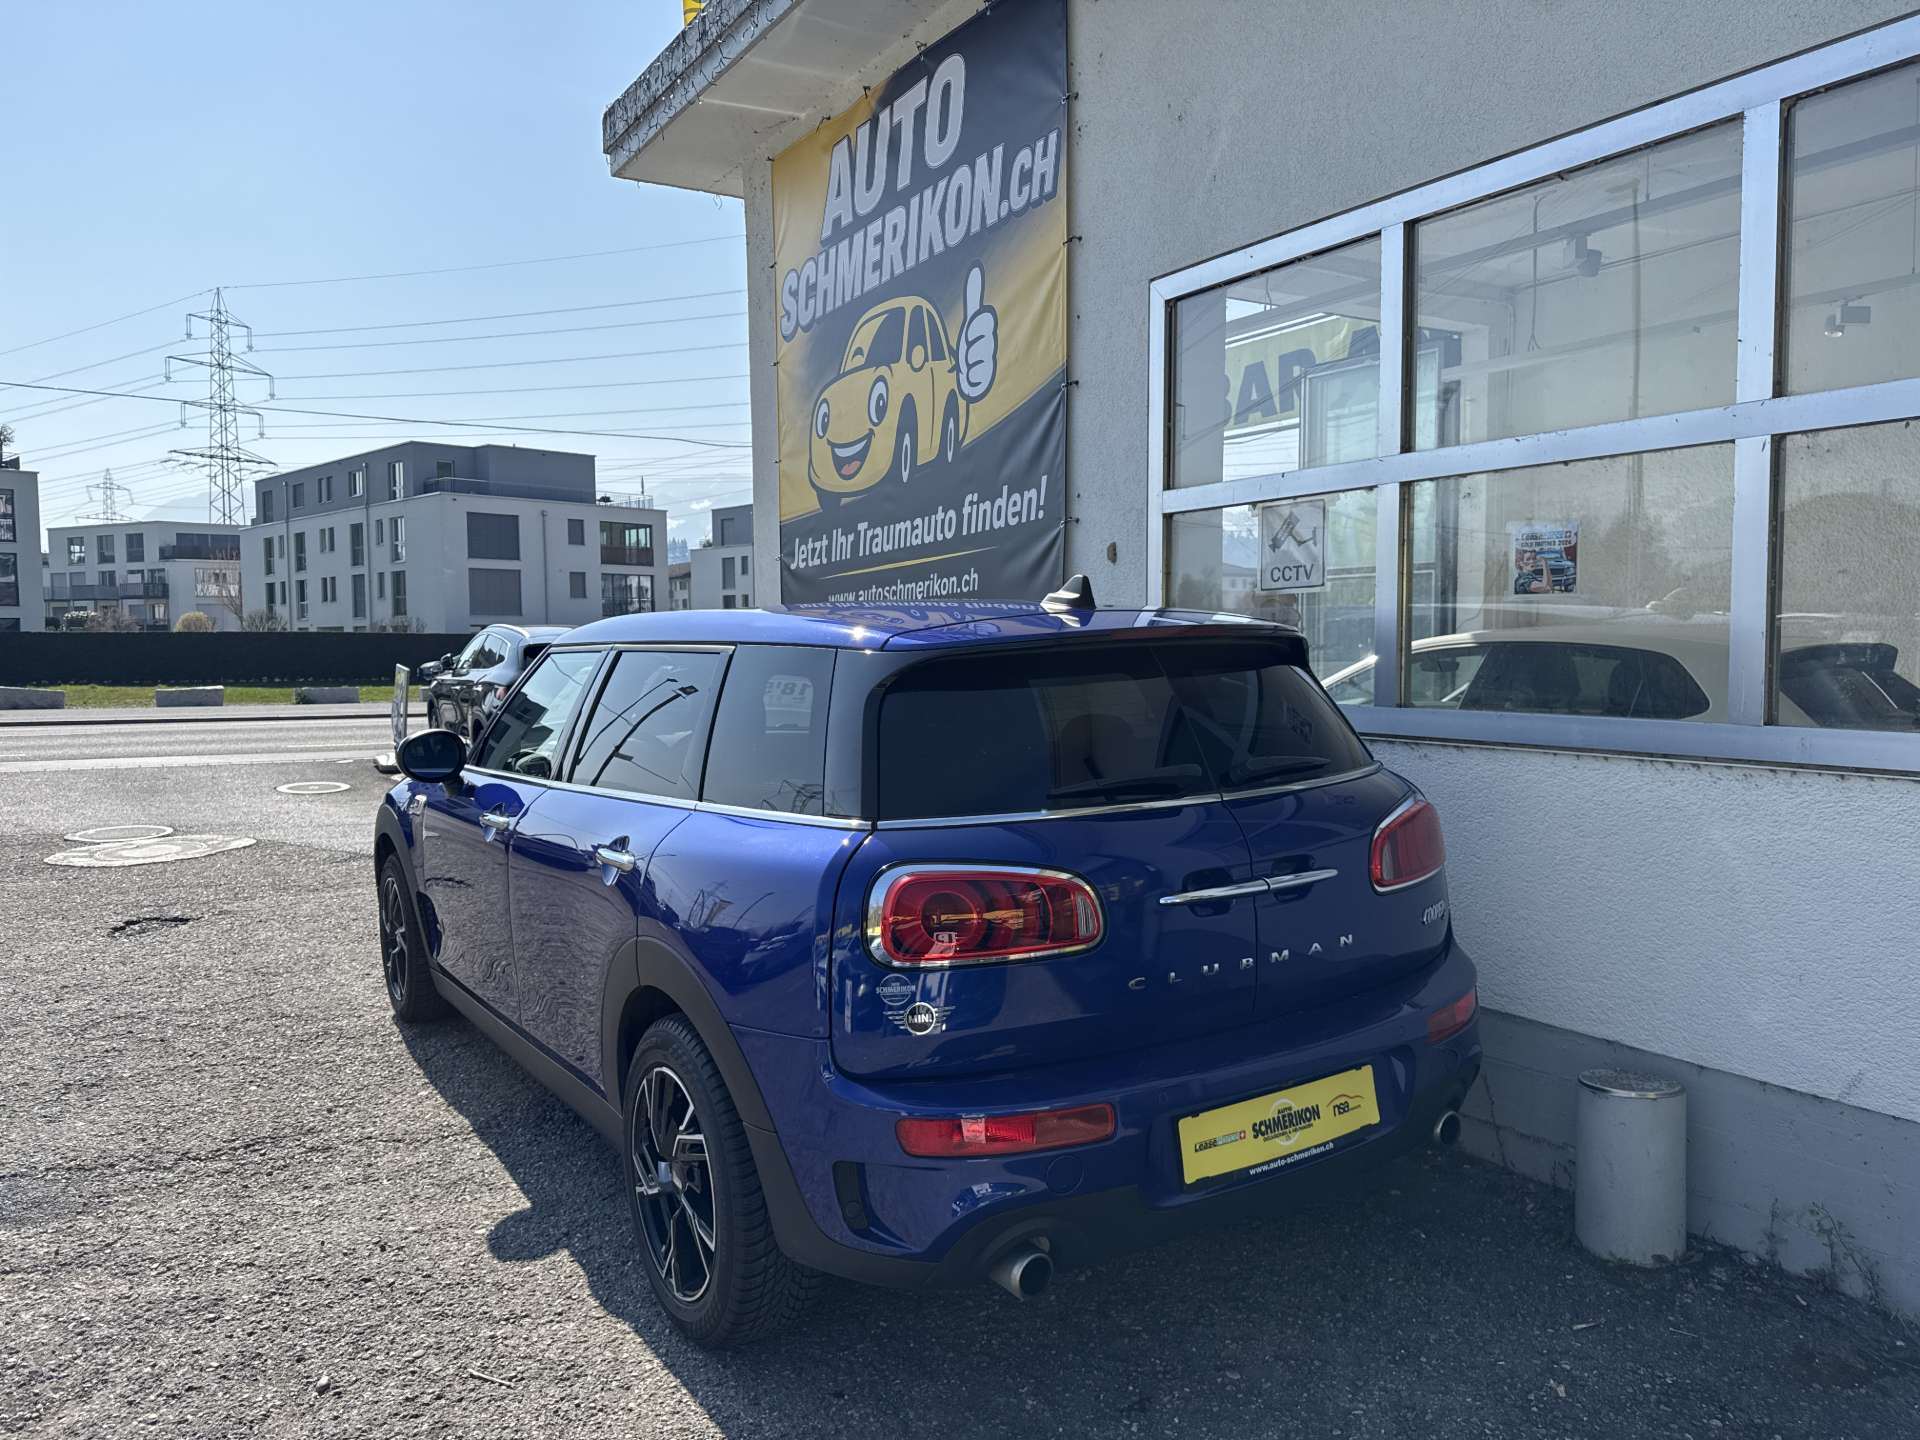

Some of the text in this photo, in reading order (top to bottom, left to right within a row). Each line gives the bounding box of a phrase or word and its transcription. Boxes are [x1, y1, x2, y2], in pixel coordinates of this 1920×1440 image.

[820, 53, 966, 243] AUTO
[780, 129, 1059, 338] SCHMERIKON.CH
[790, 475, 1048, 571] Jetzt Ihr Traumauto finden!
[828, 567, 979, 601] www.autoschmerikon.ch
[1270, 563, 1314, 583] CCTV
[1128, 934, 1353, 990] CLUBMAN
[1251, 1103, 1321, 1139] SCHMERIKON
